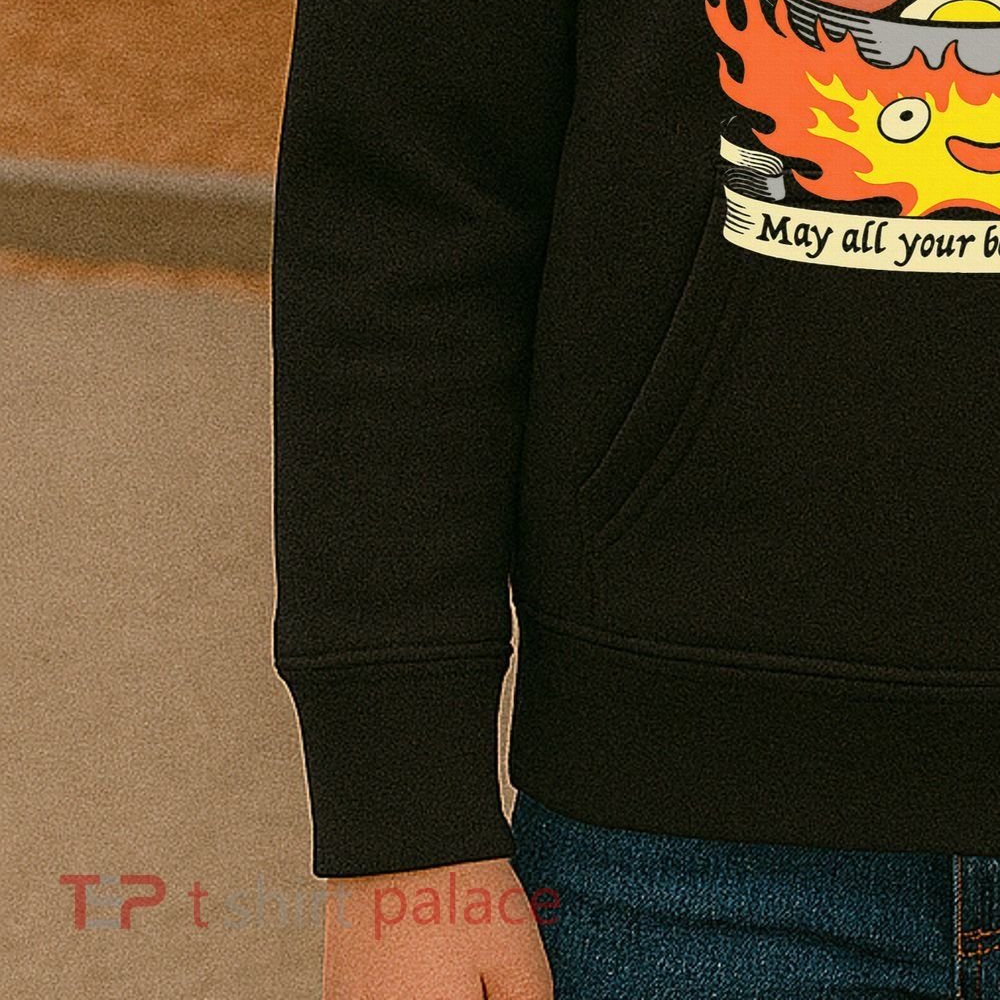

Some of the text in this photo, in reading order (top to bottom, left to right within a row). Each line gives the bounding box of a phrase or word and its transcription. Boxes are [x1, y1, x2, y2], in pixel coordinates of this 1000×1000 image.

[757, 213, 833, 257] May
[841, 220, 888, 254] all
[895, 231, 976, 266] your
